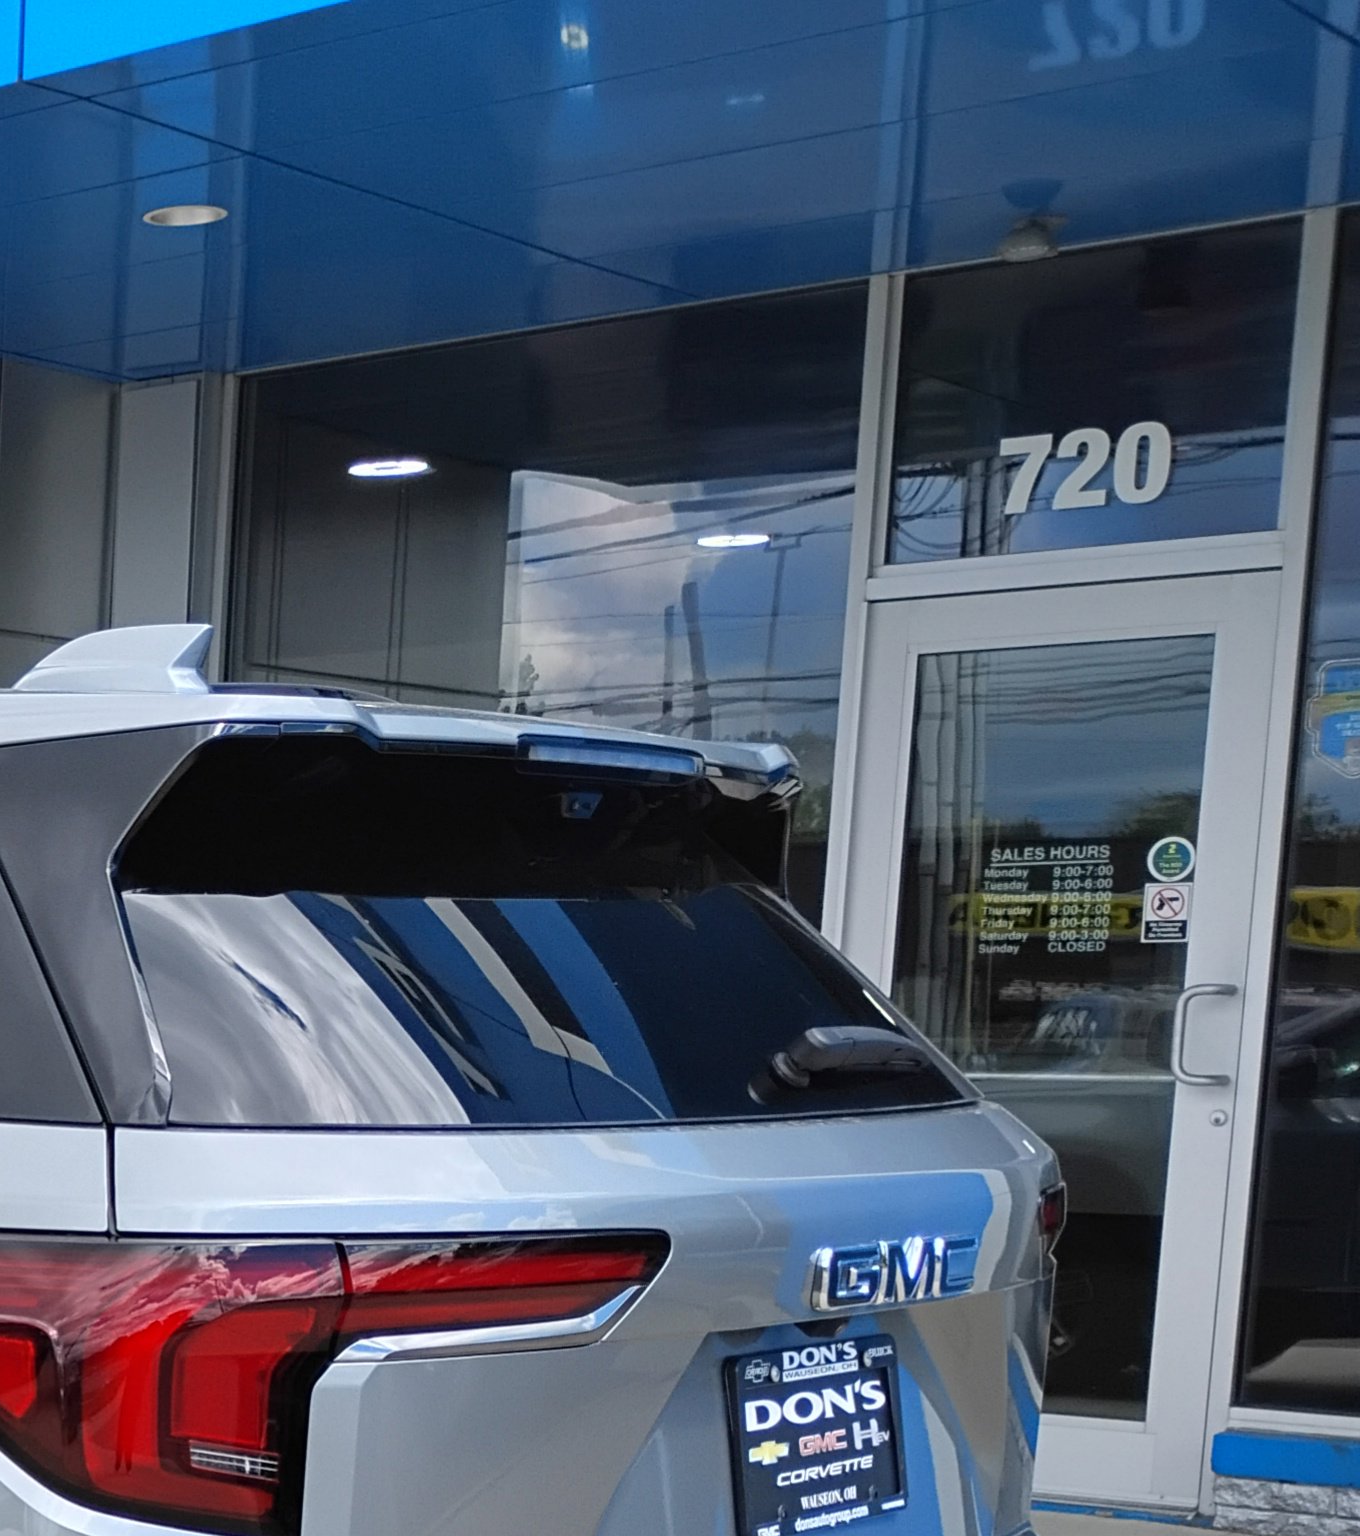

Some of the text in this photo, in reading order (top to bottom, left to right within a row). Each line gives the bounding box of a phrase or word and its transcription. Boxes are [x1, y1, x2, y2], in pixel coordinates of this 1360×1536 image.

[999, 421, 1172, 514] 720
[991, 845, 1111, 862] SALES HOURS
[984, 865, 1114, 878] Monday 9:00-7:00
[984, 878, 1113, 891] Tuesday 9:00-6:00
[982, 893, 1048, 903] Wednesday
[982, 904, 1111, 916] Thursday 9:00-7:00
[981, 916, 1110, 929] Friday 9:00-6:00
[980, 929, 1109, 942] Saturday 9:00-3:00
[979, 941, 1106, 954] Sunday CLOSED
[810, 1235, 979, 1312] GMC
[782, 1341, 858, 1371] DON'S
[841, 1361, 858, 1372] OH
[744, 1378, 886, 1432] DON'S
[799, 1429, 848, 1457] GMC
[777, 1455, 874, 1487] CORVETTE
[844, 1485, 857, 1500] OH
[795, 1505, 869, 1533] donsautogroup.com
